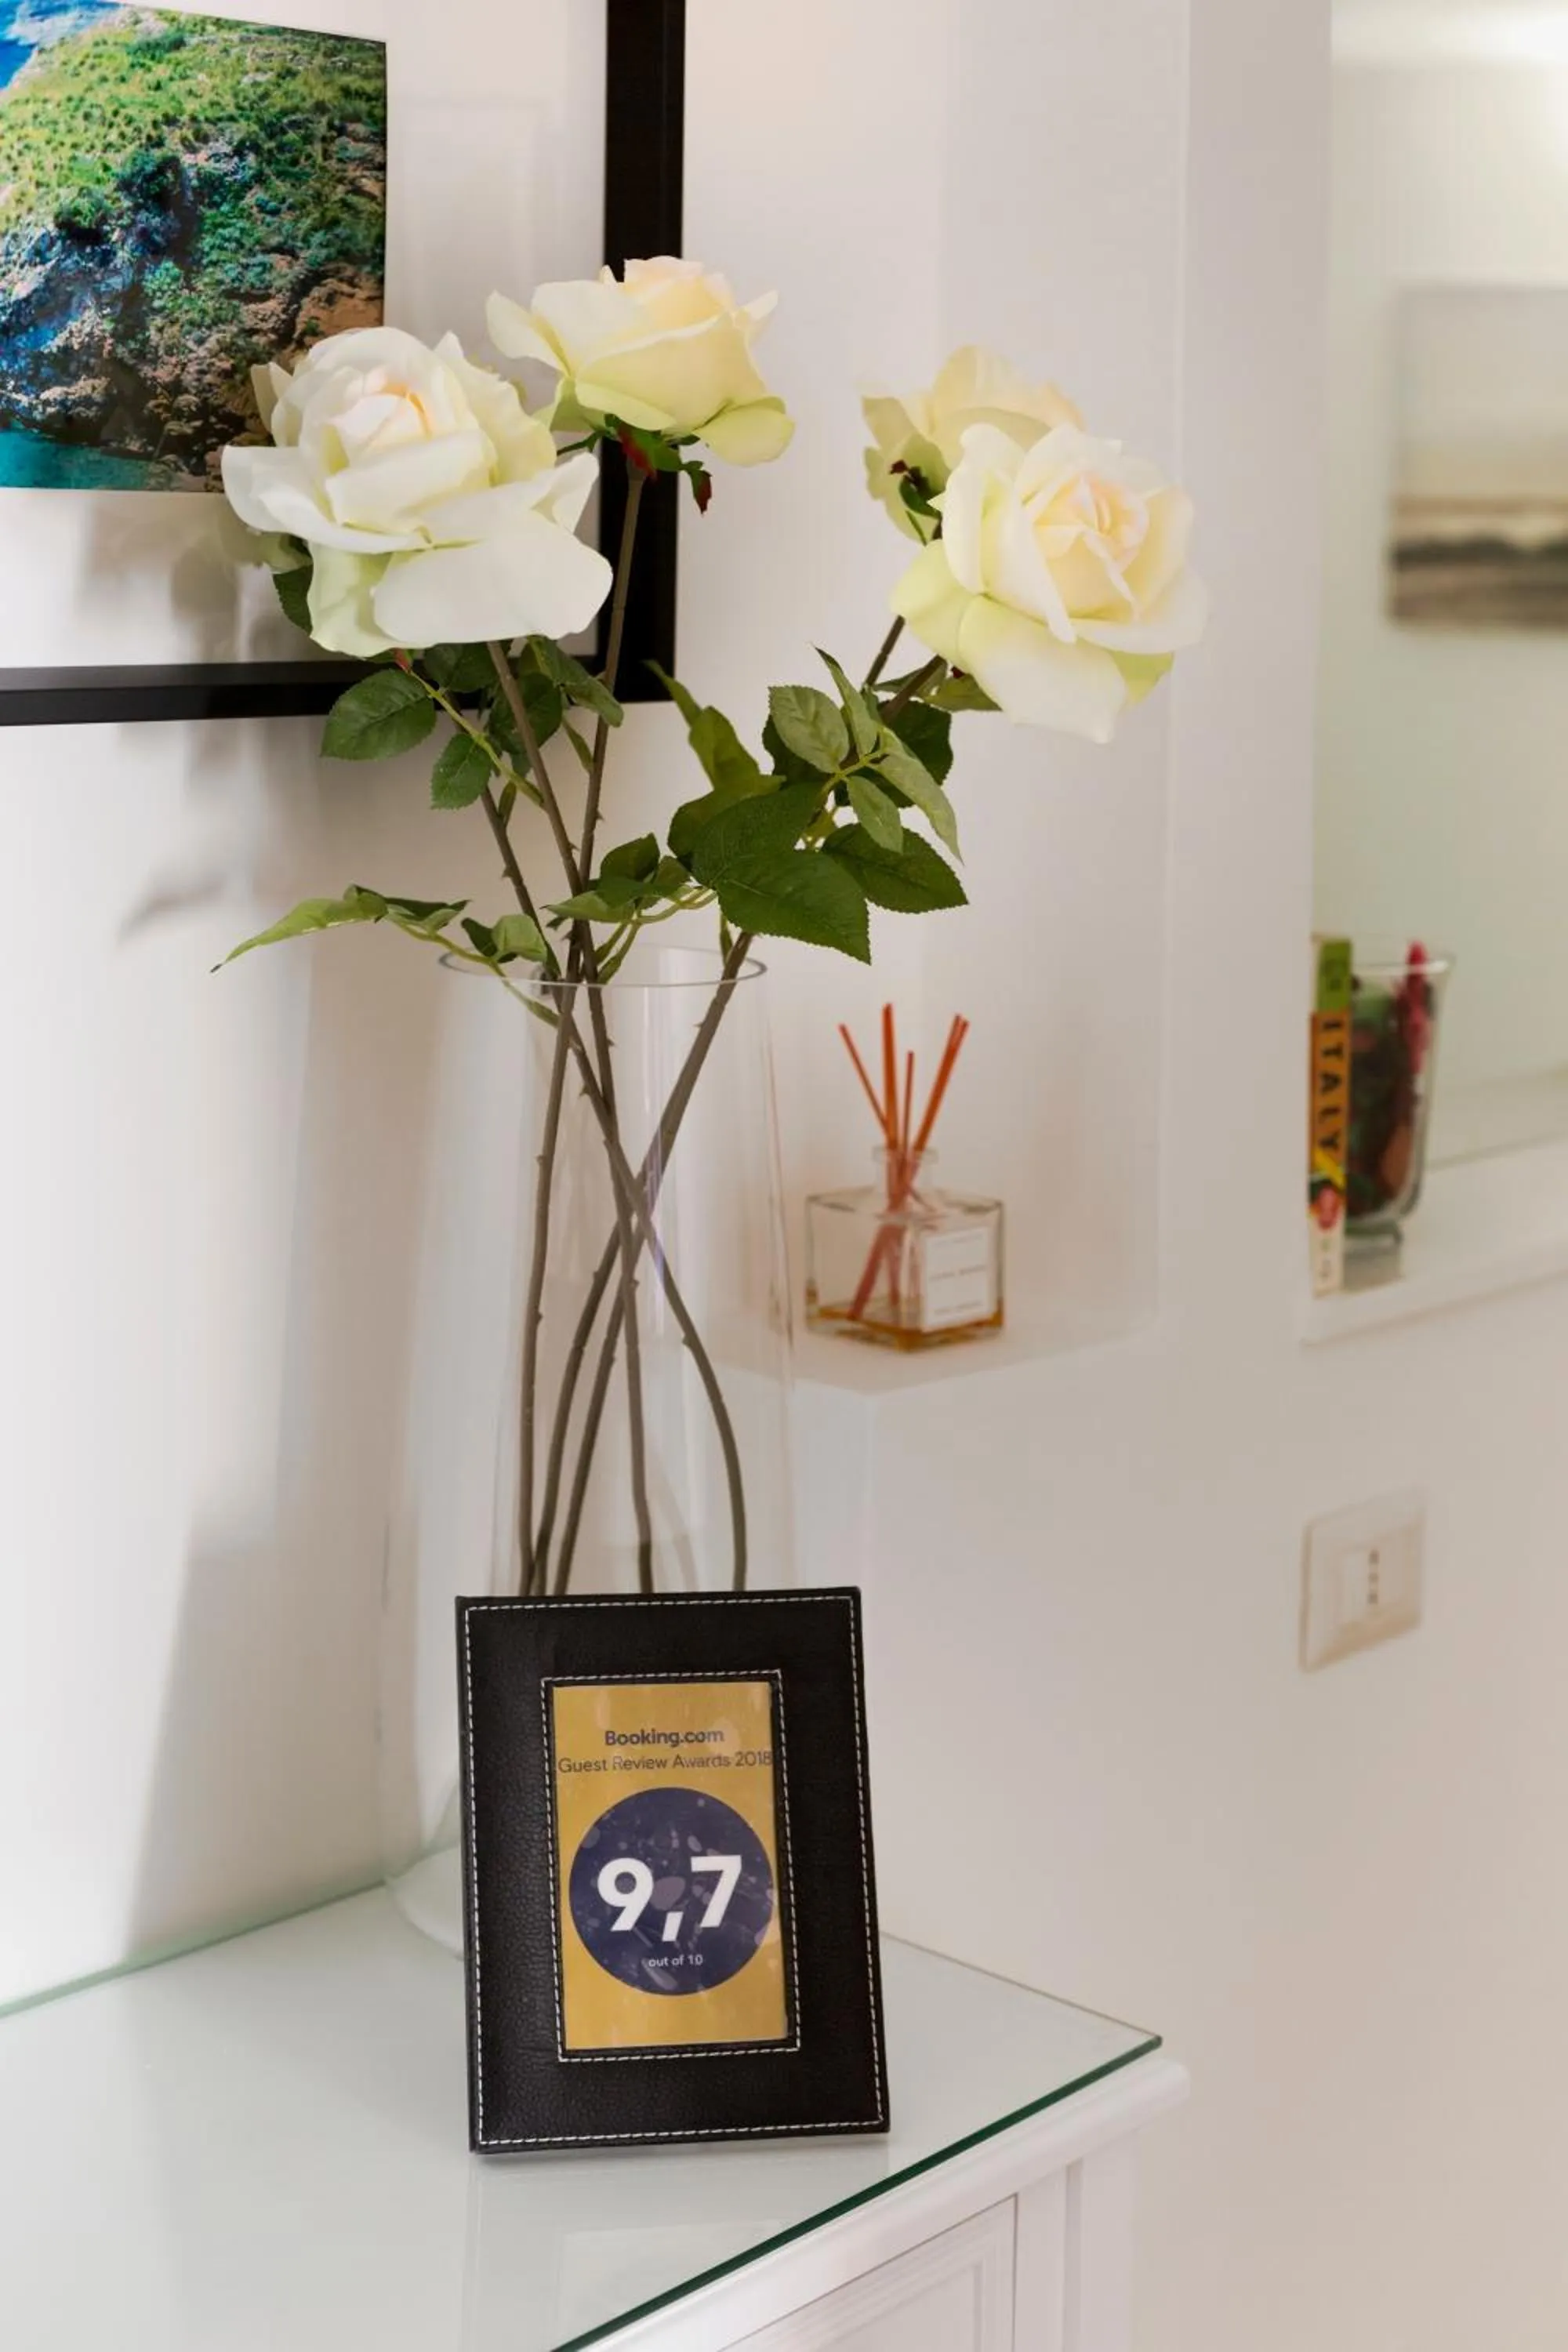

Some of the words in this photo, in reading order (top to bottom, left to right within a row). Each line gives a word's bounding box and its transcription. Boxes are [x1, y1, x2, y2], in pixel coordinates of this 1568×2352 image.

[1318, 1021, 1344, 1151] ITALY
[604, 1728, 724, 1748] Booking.com
[557, 1757, 608, 1773] Guest
[612, 1755, 667, 1770] Review
[673, 1753, 731, 1768] Awards
[735, 1750, 773, 1767] 2018
[597, 1855, 742, 1942] 9,7
[648, 1957, 669, 1967] out
[672, 1954, 684, 1966] of
[688, 1954, 703, 1965] 10
